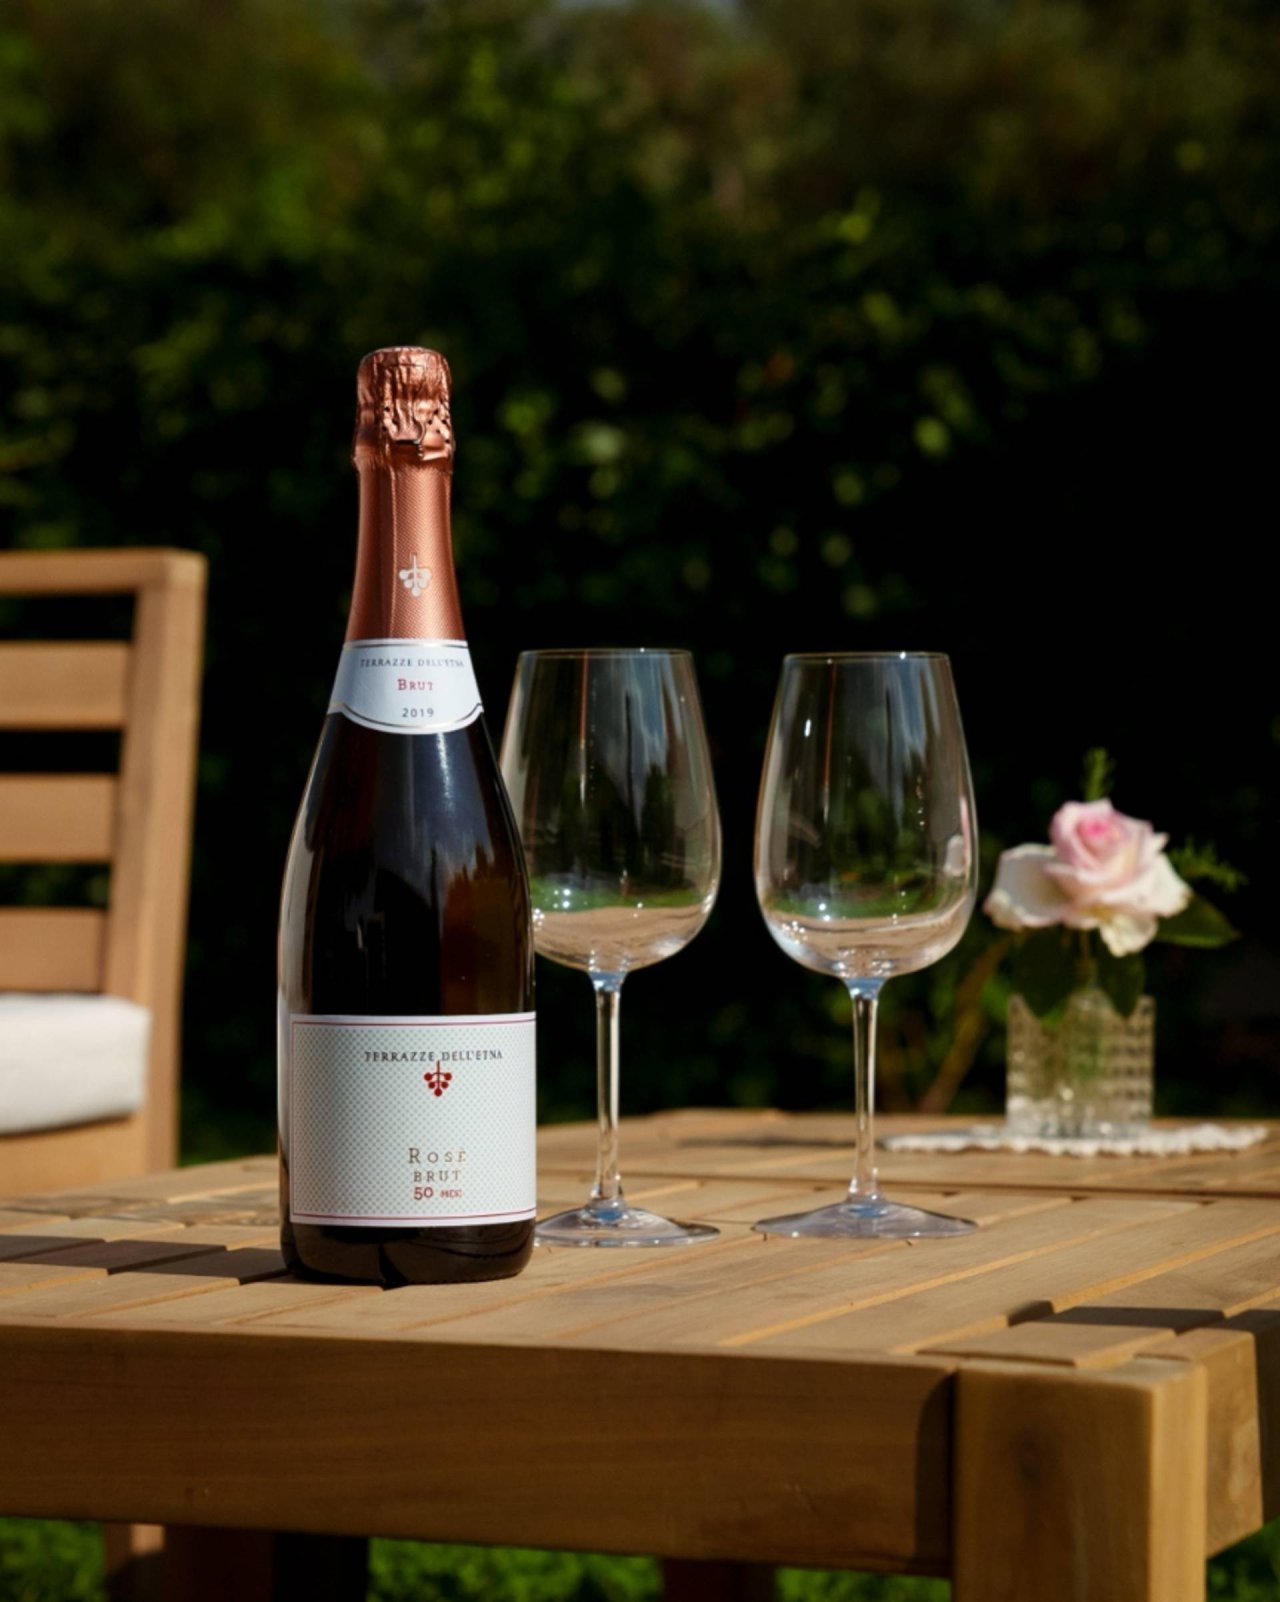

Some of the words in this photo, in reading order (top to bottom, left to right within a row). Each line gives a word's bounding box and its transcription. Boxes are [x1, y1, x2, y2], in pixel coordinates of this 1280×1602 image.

[401, 707, 435, 718] 2019
[364, 1051, 435, 1062] TERRAZZE
[441, 1050, 503, 1062] DELL'ETNA
[413, 1170, 461, 1182] BRUT
[413, 1186, 433, 1201] 50
